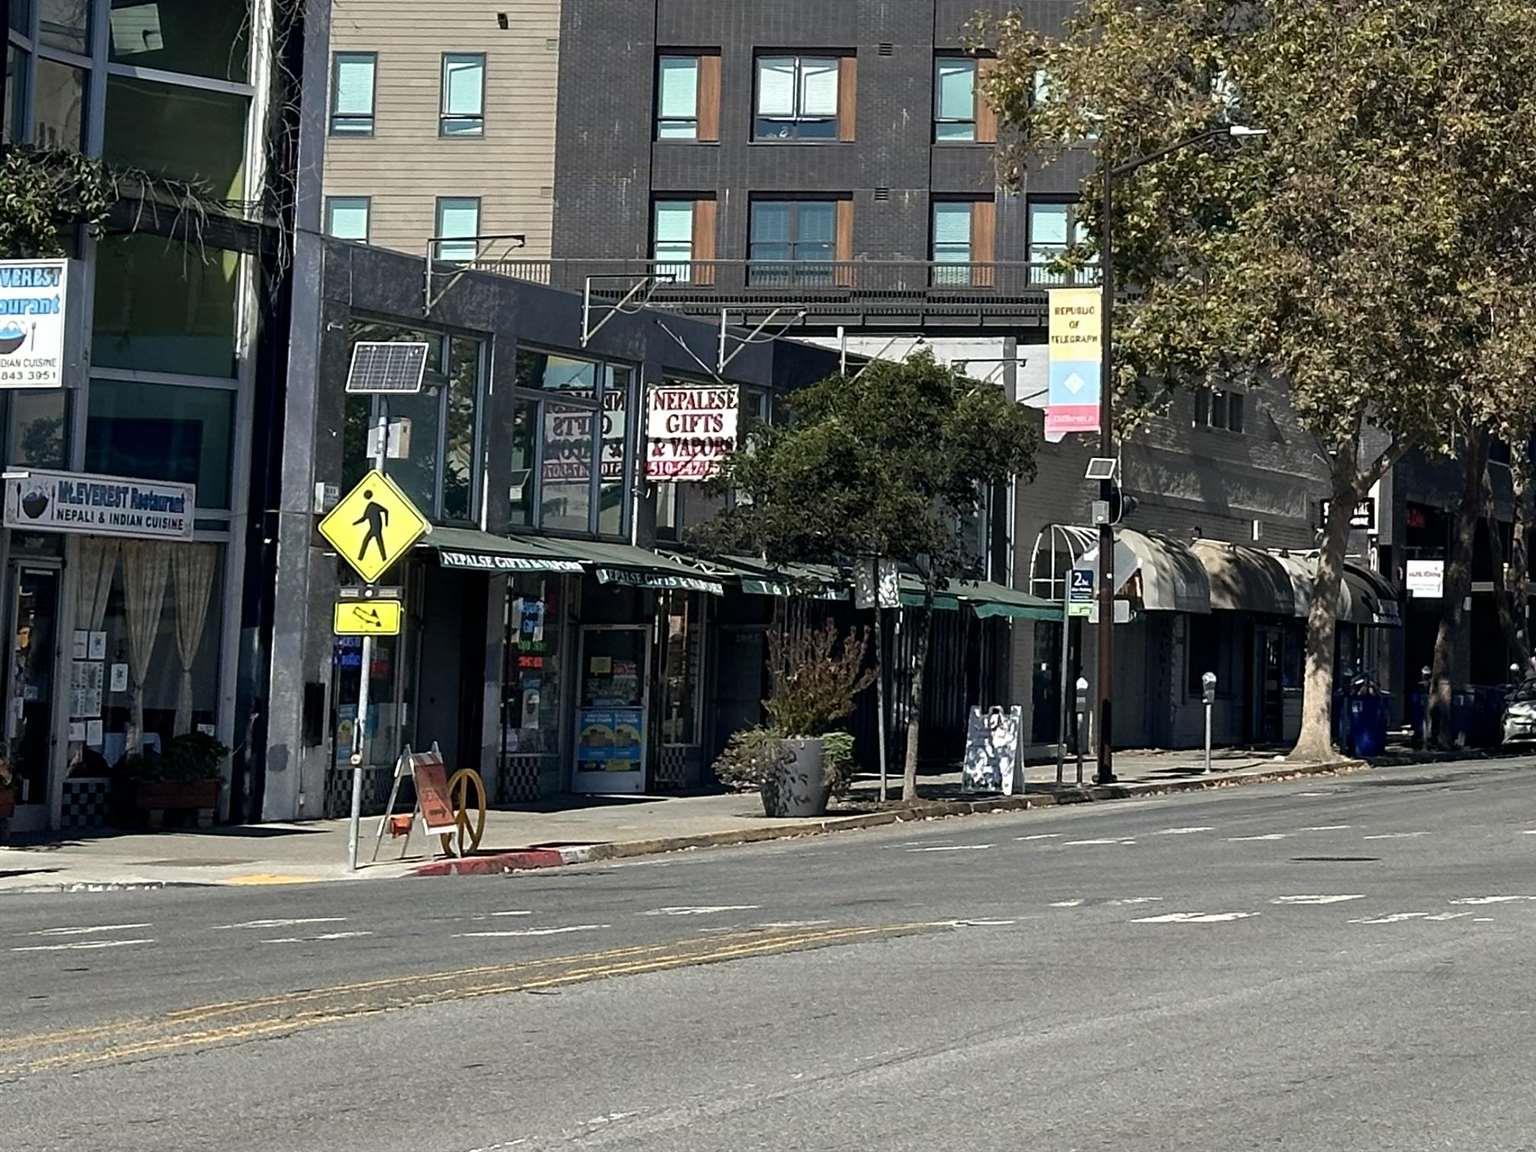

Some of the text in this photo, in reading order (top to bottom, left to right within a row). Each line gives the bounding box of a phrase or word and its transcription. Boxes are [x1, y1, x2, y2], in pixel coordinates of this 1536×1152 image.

[0, 268, 62, 287] VEREST
[0, 294, 60, 315] aurant
[1054, 306, 1094, 315] REPUBLIC
[1068, 321, 1079, 329] OF
[1051, 335, 1097, 344] TELEGRAPH
[0, 358, 56, 367] DIAN CUISINE
[1, 371, 56, 380] 843 3951
[653, 391, 738, 410] NEPALESE
[666, 414, 723, 433] GIFTS
[652, 437, 734, 457] & VAPORS
[131, 488, 185, 513] Restaurant
[56, 509, 183, 530] NEPALI & INDIAN CUISINE
[441, 551, 495, 568] NEPALSE
[495, 556, 528, 569] GIFTS
[1073, 572, 1082, 586] 2
